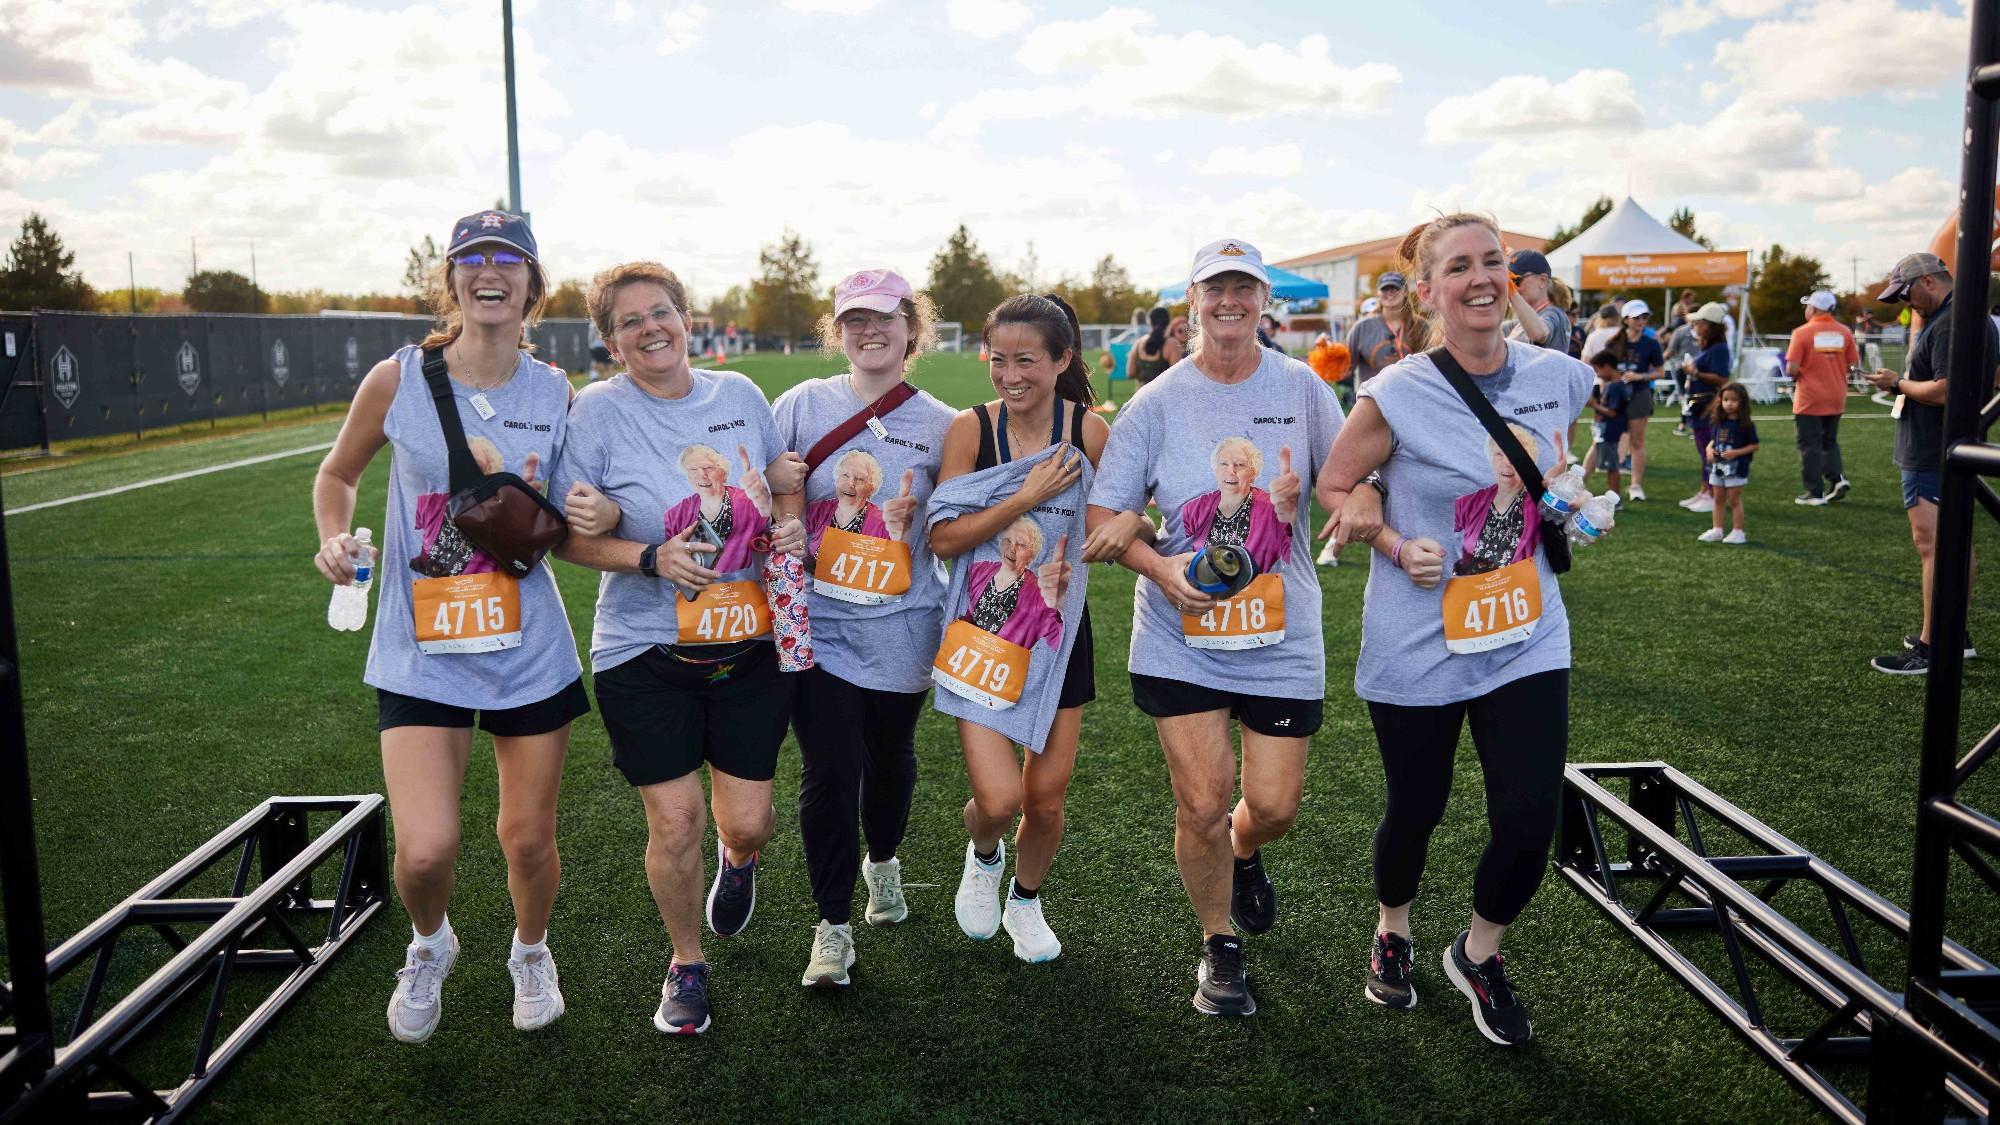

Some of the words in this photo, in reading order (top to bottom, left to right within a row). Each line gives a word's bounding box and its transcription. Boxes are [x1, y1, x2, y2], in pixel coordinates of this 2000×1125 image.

[1626, 255, 1651, 264] Team
[1625, 276, 1641, 285] the
[1513, 403, 1543, 416] CAROL'S
[1543, 400, 1559, 411] KIDS
[534, 424, 551, 433] KIDS
[1253, 416, 1282, 425] CAROL'S
[885, 436, 914, 449] CAROL'S
[914, 443, 930, 454] KIDS
[1061, 508, 1076, 517] KIDS
[830, 552, 895, 590] 4717
[433, 596, 505, 636] 4715
[1200, 598, 1266, 632] 4718
[1464, 587, 1529, 633] 4716
[696, 603, 758, 640] 4720
[947, 645, 1010, 692] 4719
